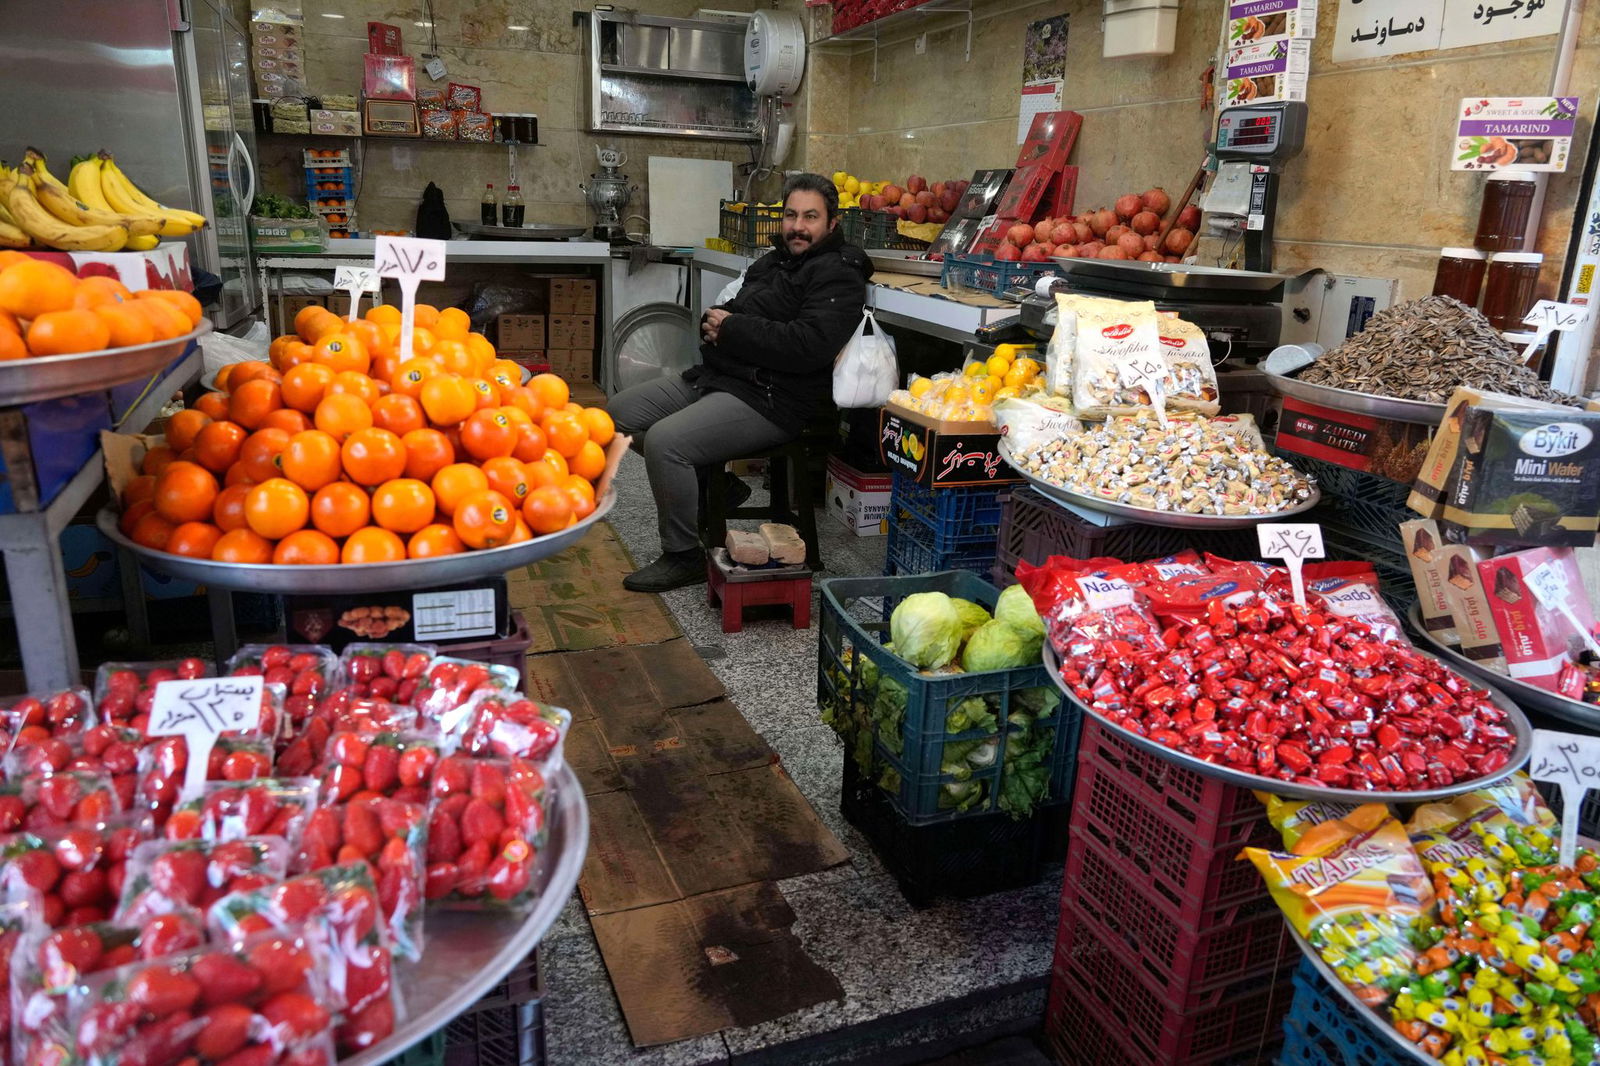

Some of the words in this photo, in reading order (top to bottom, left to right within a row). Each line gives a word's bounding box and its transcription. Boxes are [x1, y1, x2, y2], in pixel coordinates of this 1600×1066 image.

[1243, 0, 1284, 15] TAMARIND
[1473, 0, 1546, 26] موجود
[1350, 16, 1425, 46] دماوند
[1239, 63, 1274, 76] TAMARIND
[1486, 109, 1510, 117] SWEET
[1560, 98, 1576, 111] NEW
[1484, 124, 1550, 134] TAMARIND
[389, 243, 438, 274] ۱۷۰
[1296, 421, 1314, 431] NEW
[1322, 423, 1367, 442] ZAHEDI
[1327, 435, 1359, 451] DATE
[1534, 430, 1579, 453] Bykit
[1514, 458, 1547, 475] Mini
[1548, 462, 1584, 477] Wafer
[864, 505, 891, 513] ANANAS
[1327, 589, 1372, 604] Nado
[1465, 597, 1479, 616] ویفر
[1473, 617, 1488, 640] مینی
[1518, 631, 1534, 657] مینی
[1558, 742, 1600, 785] ۳۰
